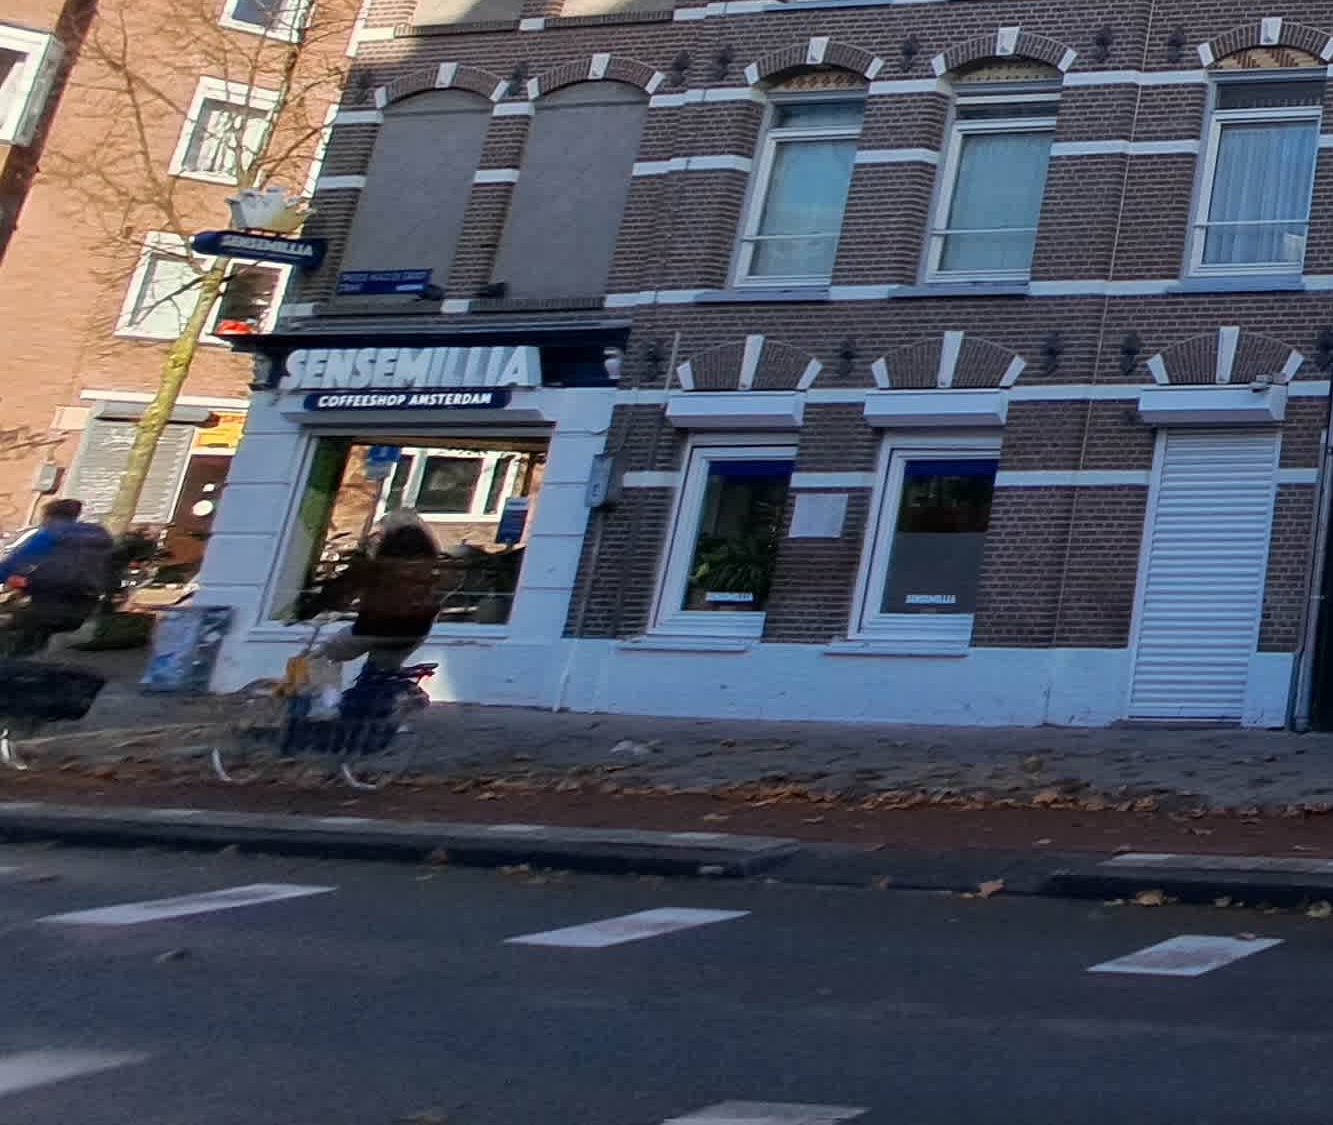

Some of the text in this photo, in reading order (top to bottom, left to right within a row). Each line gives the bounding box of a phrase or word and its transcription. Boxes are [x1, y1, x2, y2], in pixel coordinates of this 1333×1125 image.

[278, 345, 542, 389] SENSEMILLIA
[317, 393, 492, 408] COFFEESHOP AMSTERDAM
